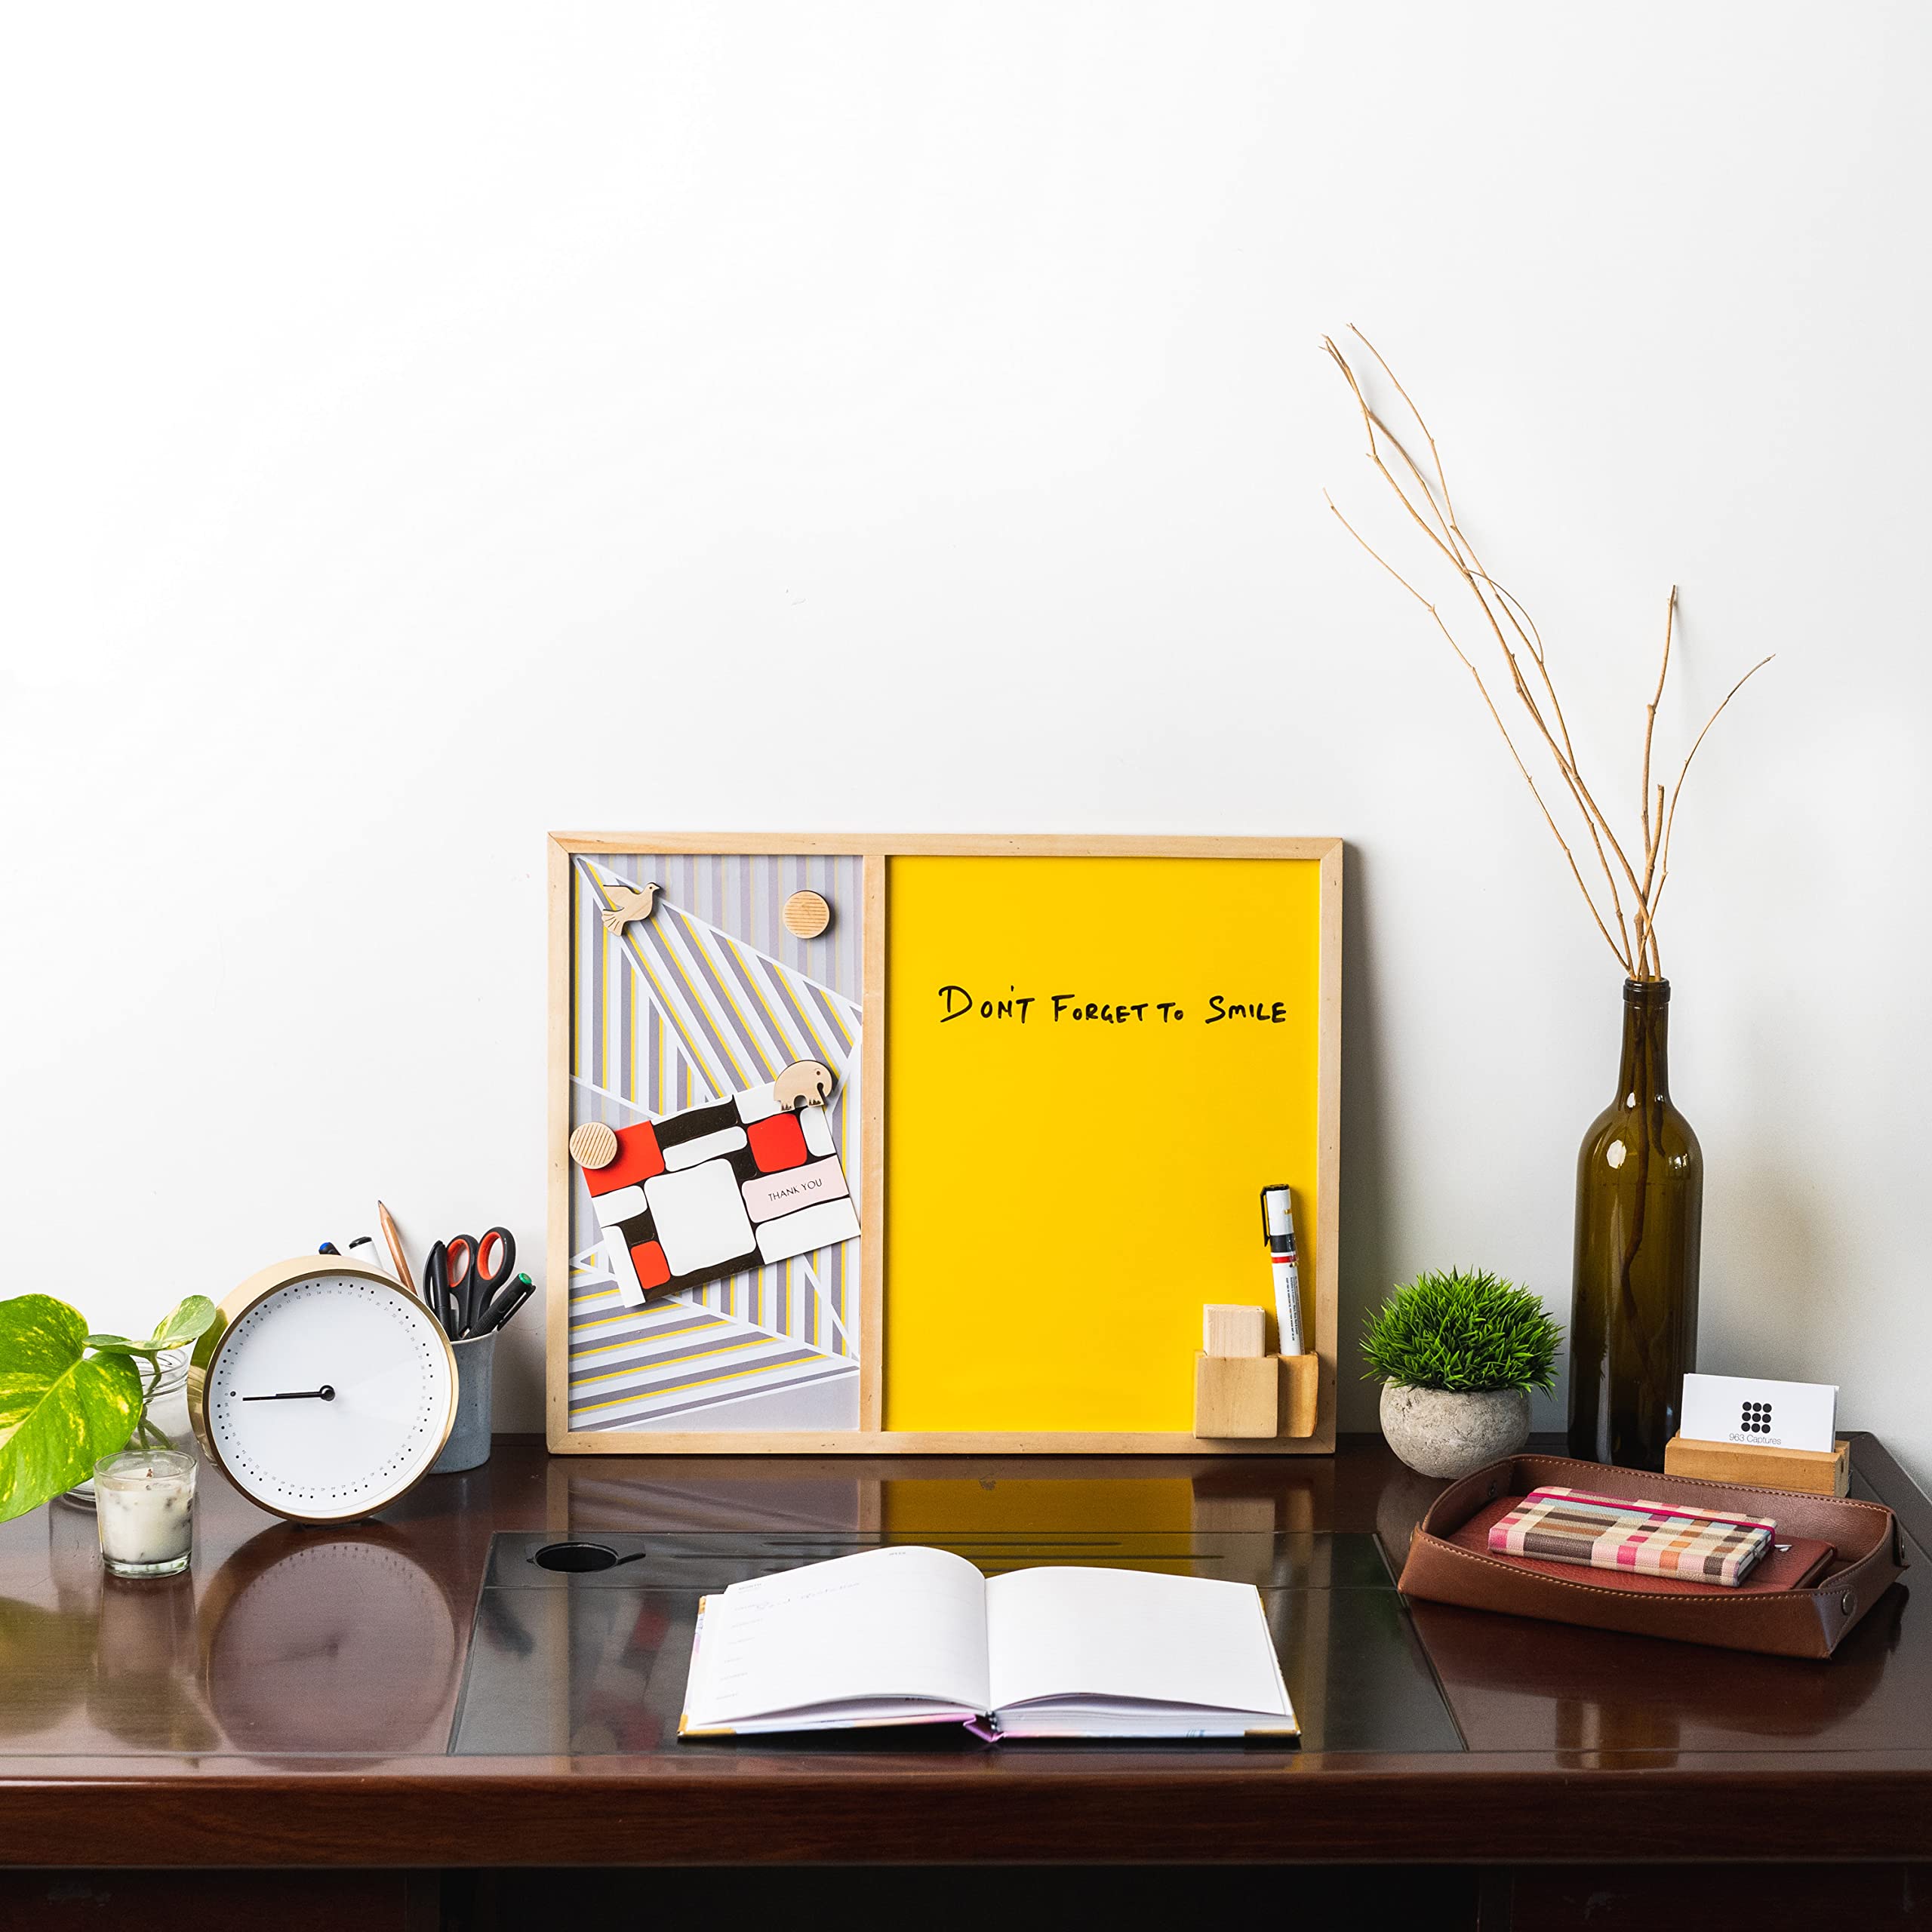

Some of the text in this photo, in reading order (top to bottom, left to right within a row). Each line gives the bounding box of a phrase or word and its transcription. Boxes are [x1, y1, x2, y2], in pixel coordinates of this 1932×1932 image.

[1051, 995, 1148, 1023] FORGET
[1157, 1002, 1183, 1023] TO
[1205, 995, 1286, 1024] SMILE
[768, 1179, 822, 1201] THANK YOU
[1729, 1433, 1782, 1444] 963 Captures
